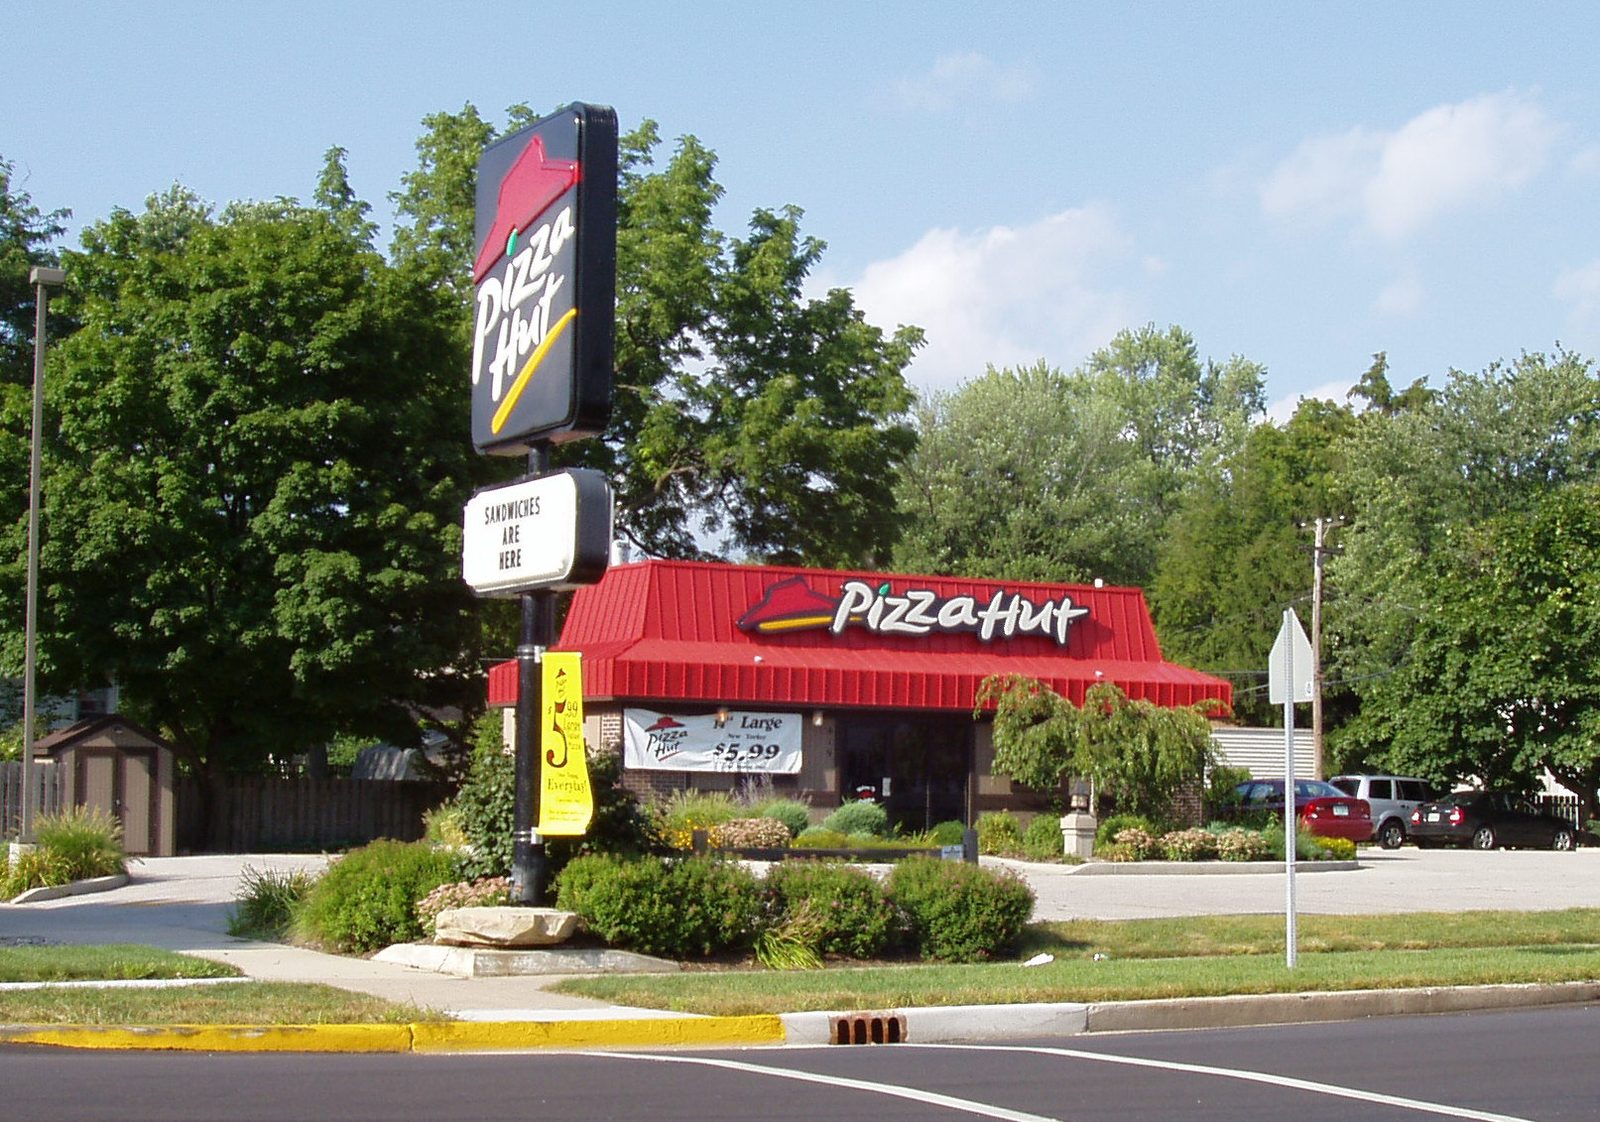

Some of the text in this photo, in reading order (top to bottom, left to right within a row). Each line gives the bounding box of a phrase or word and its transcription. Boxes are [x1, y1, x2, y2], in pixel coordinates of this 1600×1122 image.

[472, 206, 575, 385] Pizza
[489, 272, 565, 402] Hut
[484, 496, 540, 525] SANDWICHES
[502, 524, 520, 546] ARE
[499, 549, 522, 570] HERE
[832, 581, 1089, 645] Pizza Hut
[740, 715, 783, 731] Large
[646, 728, 689, 753] Pizza
[655, 741, 683, 758] Hut
[713, 742, 781, 762] $5.99
